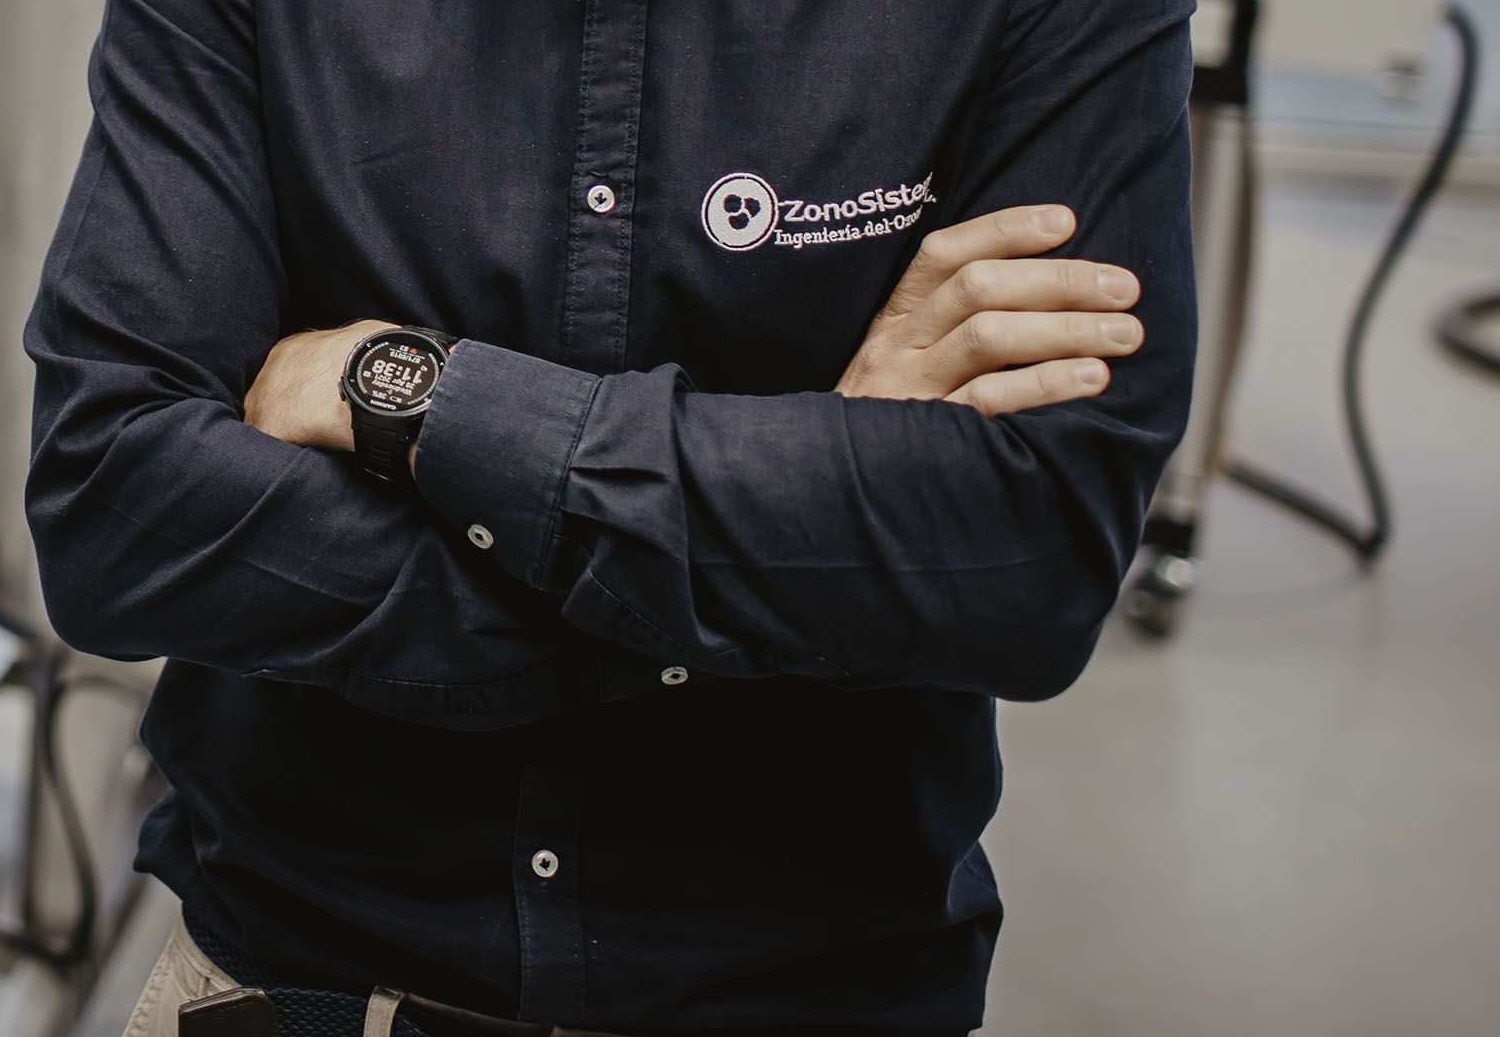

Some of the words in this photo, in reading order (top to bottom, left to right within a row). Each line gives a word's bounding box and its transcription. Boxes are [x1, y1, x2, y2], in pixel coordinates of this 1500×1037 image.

[865, 218, 890, 238] del
[372, 360, 422, 383] 11:38
[374, 374, 391, 383] 2021
[392, 378, 405, 387] Apr
[372, 380, 412, 396] Wednesday
[370, 399, 396, 410] GARMIN
